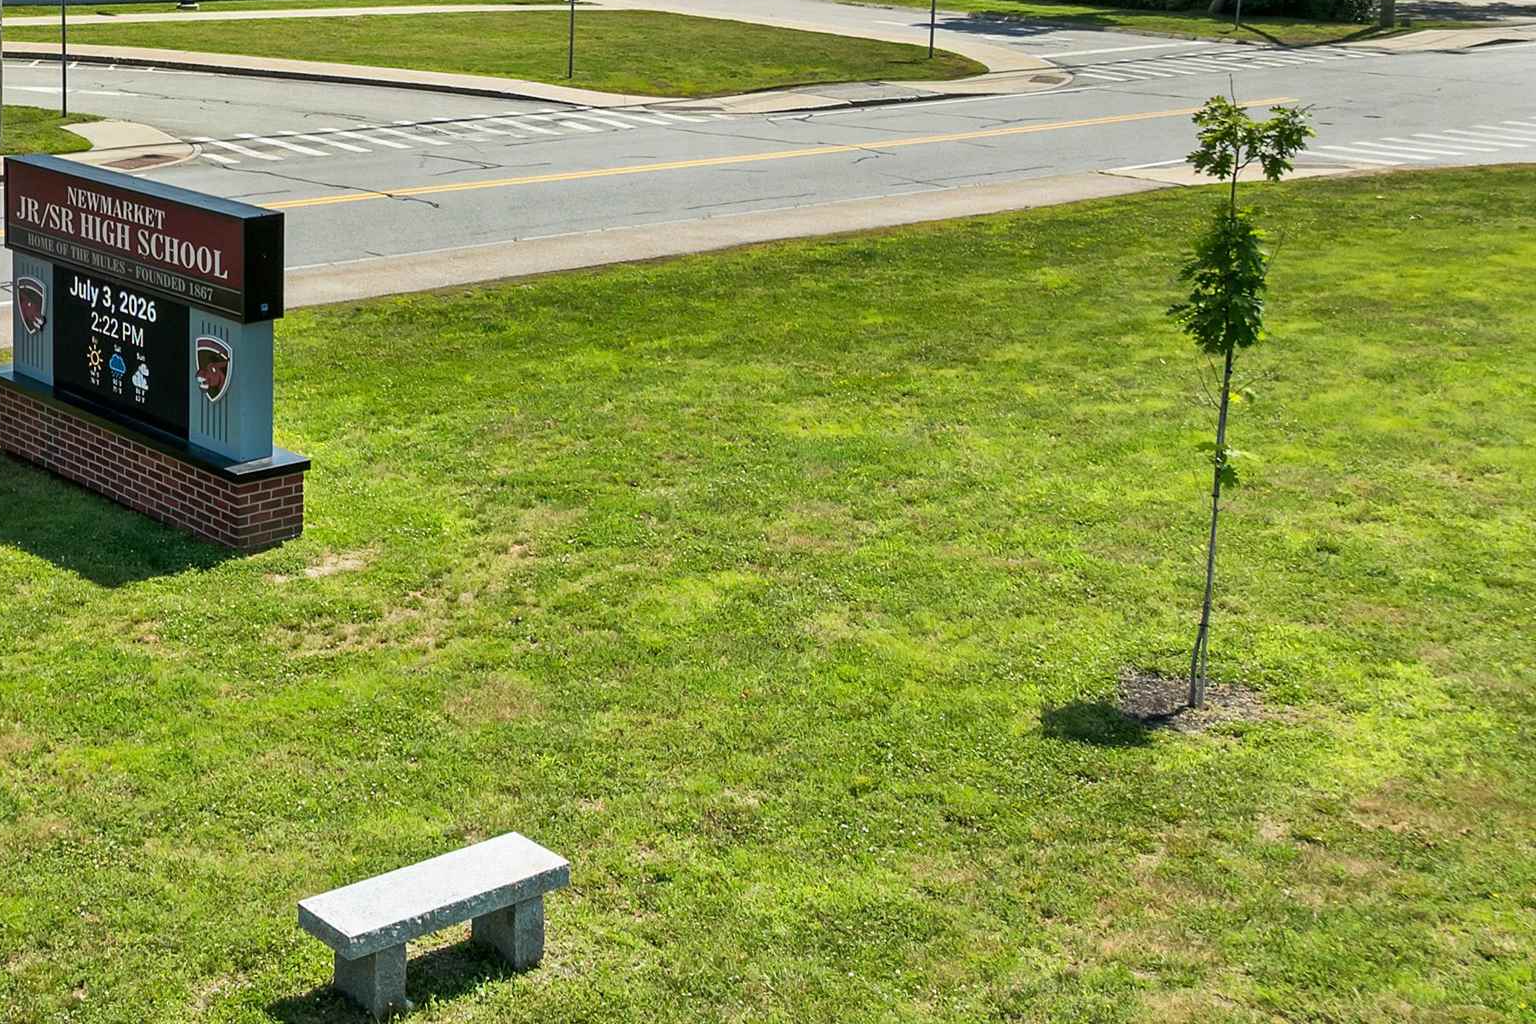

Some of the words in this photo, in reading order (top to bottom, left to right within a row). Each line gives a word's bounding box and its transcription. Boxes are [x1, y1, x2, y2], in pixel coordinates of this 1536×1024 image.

[67, 185, 166, 230] NEWMARKET
[16, 195, 74, 235] JR/SR
[80, 212, 131, 251] HIGH
[137, 228, 229, 280] SCHOOL
[27, 232, 55, 253] HOME
[56, 241, 69, 256] OF
[70, 245, 90, 264] THE
[91, 254, 126, 274] MULES
[135, 264, 186, 292] FOUNDED
[189, 282, 214, 302] 1867
[69, 275, 99, 308] July
[102, 285, 116, 314] 3,
[119, 290, 157, 323] 2026
[90, 311, 120, 339] 2:22
[122, 321, 144, 348] PM
